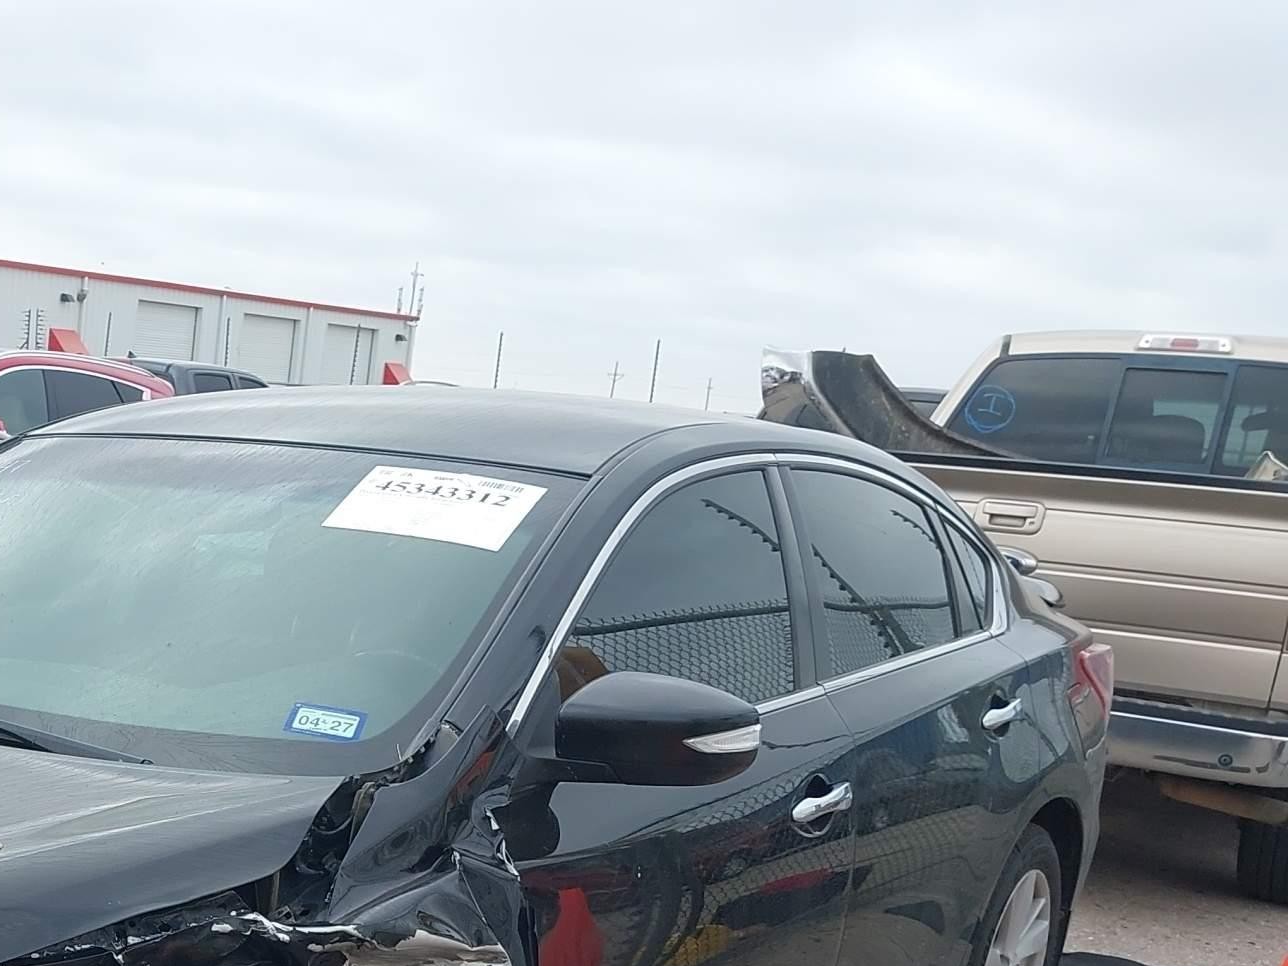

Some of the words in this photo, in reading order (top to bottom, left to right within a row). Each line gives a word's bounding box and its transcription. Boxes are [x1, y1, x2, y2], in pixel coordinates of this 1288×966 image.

[375, 480, 511, 507] 45343312
[298, 715, 321, 727] 04
[329, 720, 354, 733] 27
